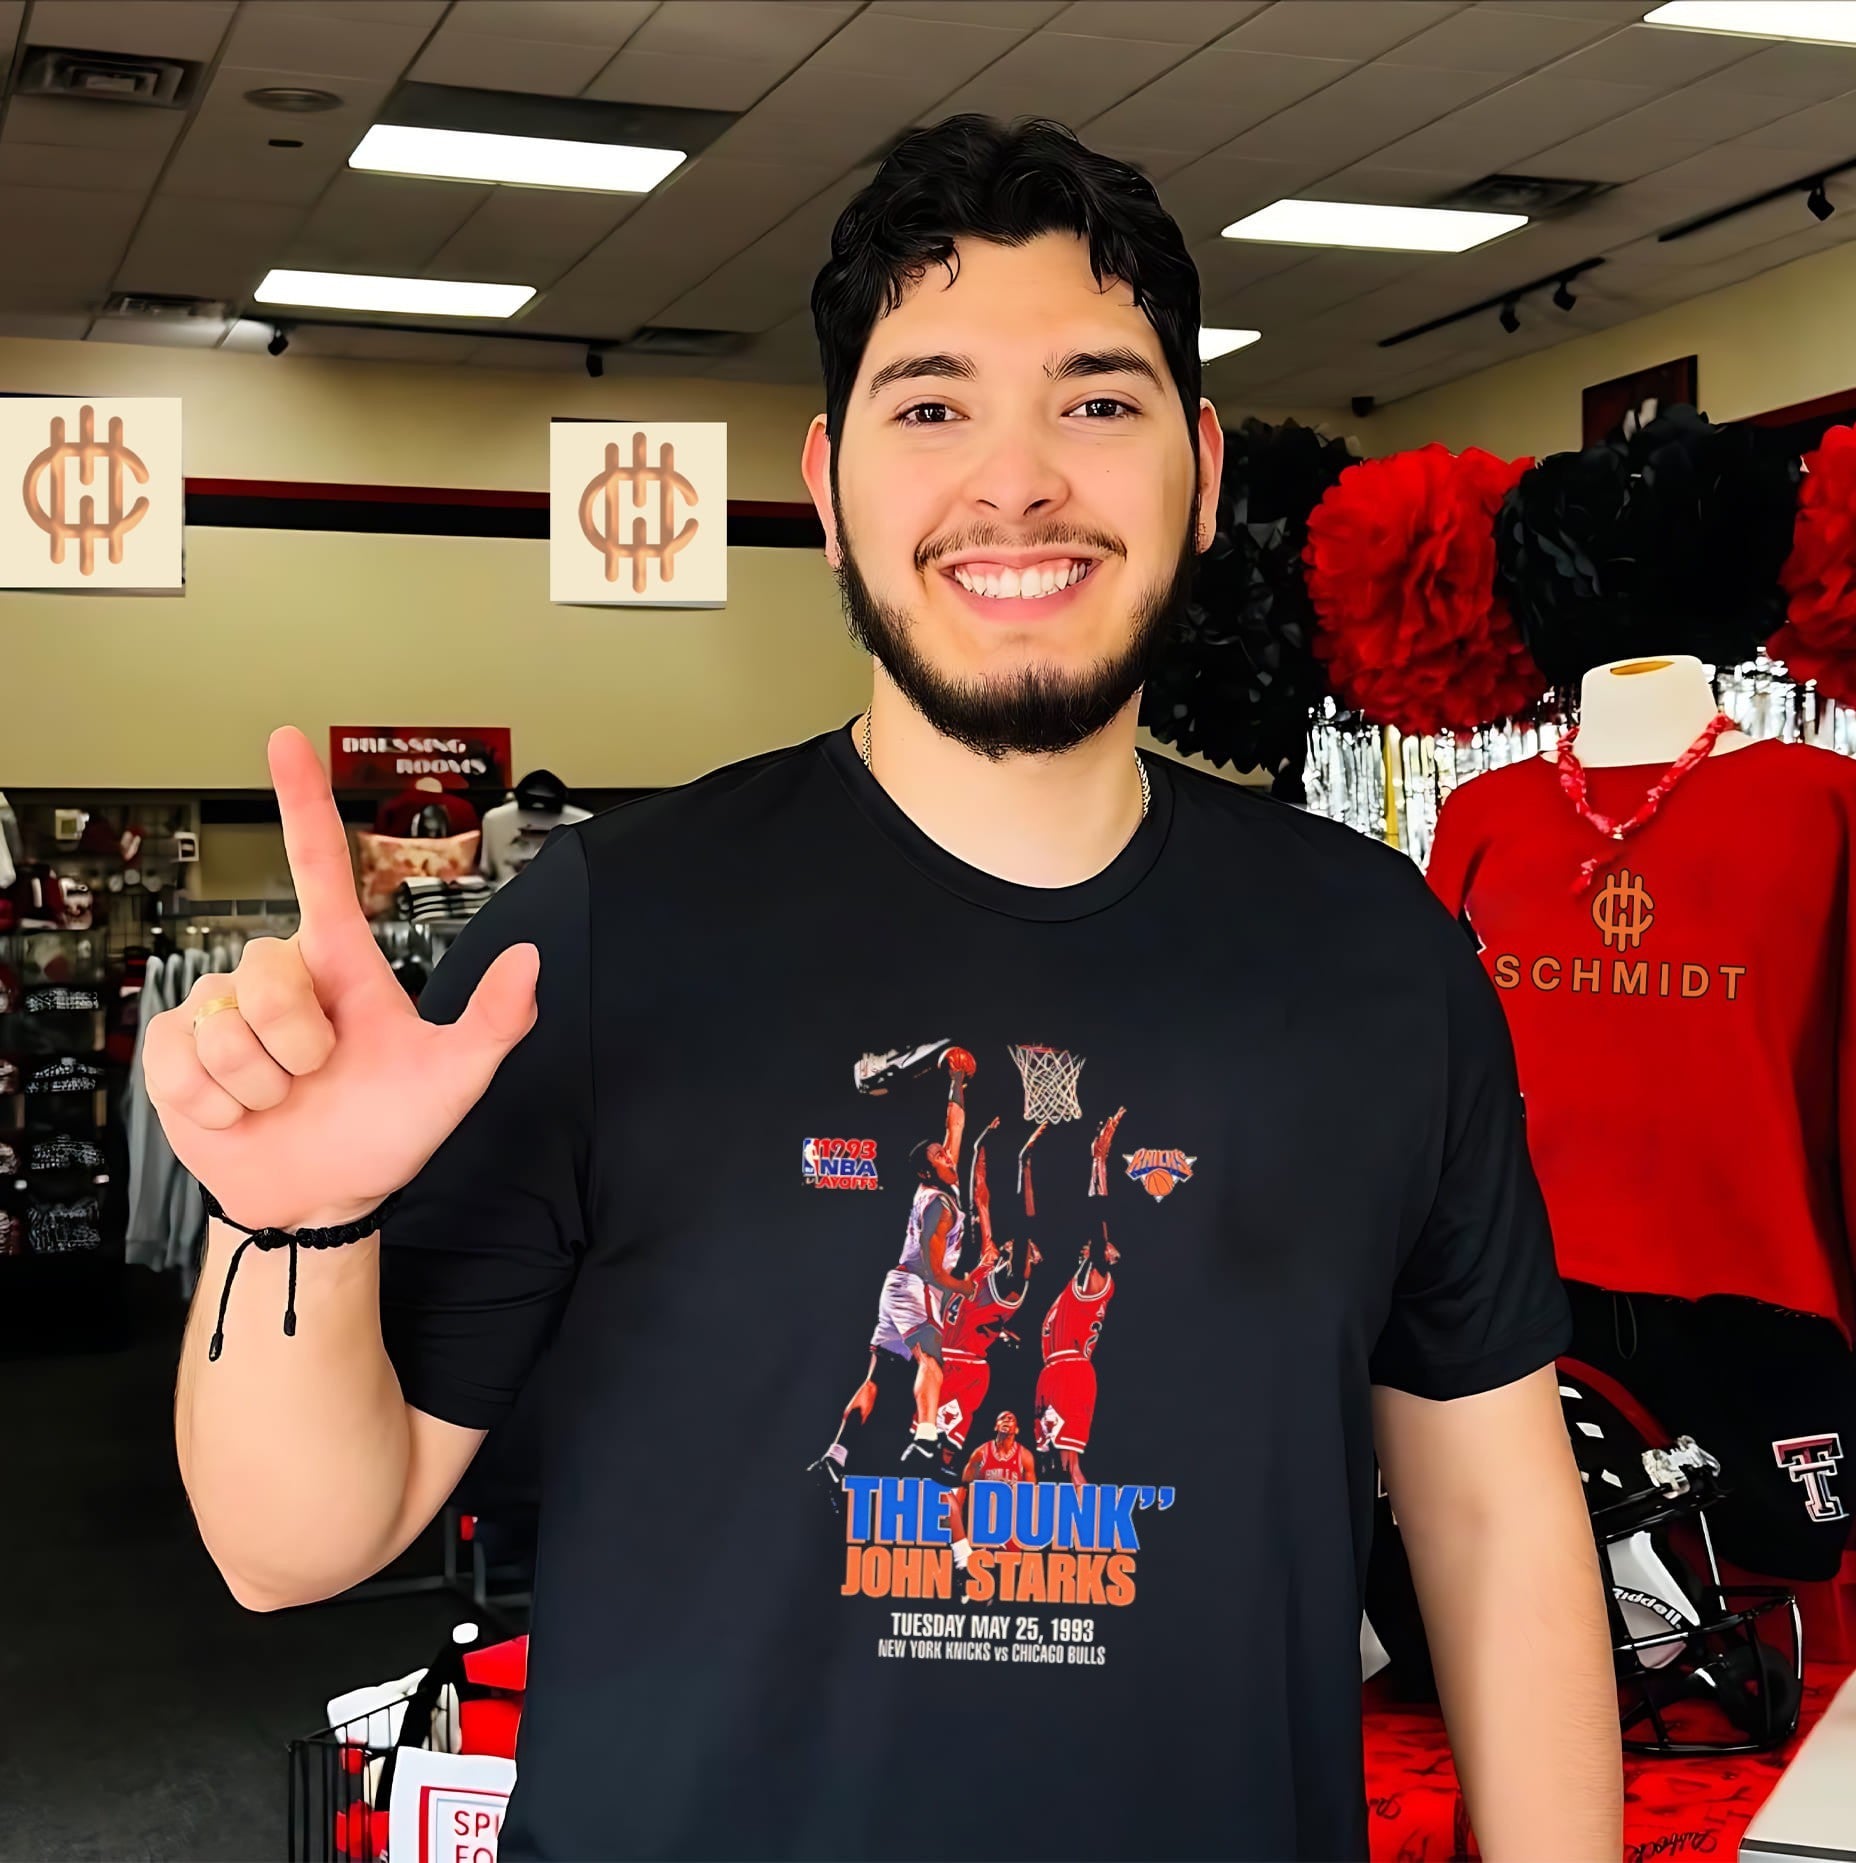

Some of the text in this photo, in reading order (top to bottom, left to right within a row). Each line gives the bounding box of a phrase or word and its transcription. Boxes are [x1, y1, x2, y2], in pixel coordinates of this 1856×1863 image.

[342, 737, 467, 754] DRESSING
[396, 758, 487, 775] ROOMS
[1495, 954, 1746, 1000] SCHMIDT
[820, 1138, 878, 1160] 1993
[820, 1159, 878, 1176] NBA
[841, 1475, 953, 1546] THE
[840, 1545, 1137, 1607] JOHN STARKS
[890, 1612, 1095, 1644] TUESDAY MAY 25, 1993
[877, 1638, 906, 1658] NEW
[909, 1640, 942, 1660] YORK
[945, 1641, 991, 1662] KNICKS
[1011, 1643, 1064, 1664] CHICAGO
[1067, 1645, 1106, 1665] BULLS
